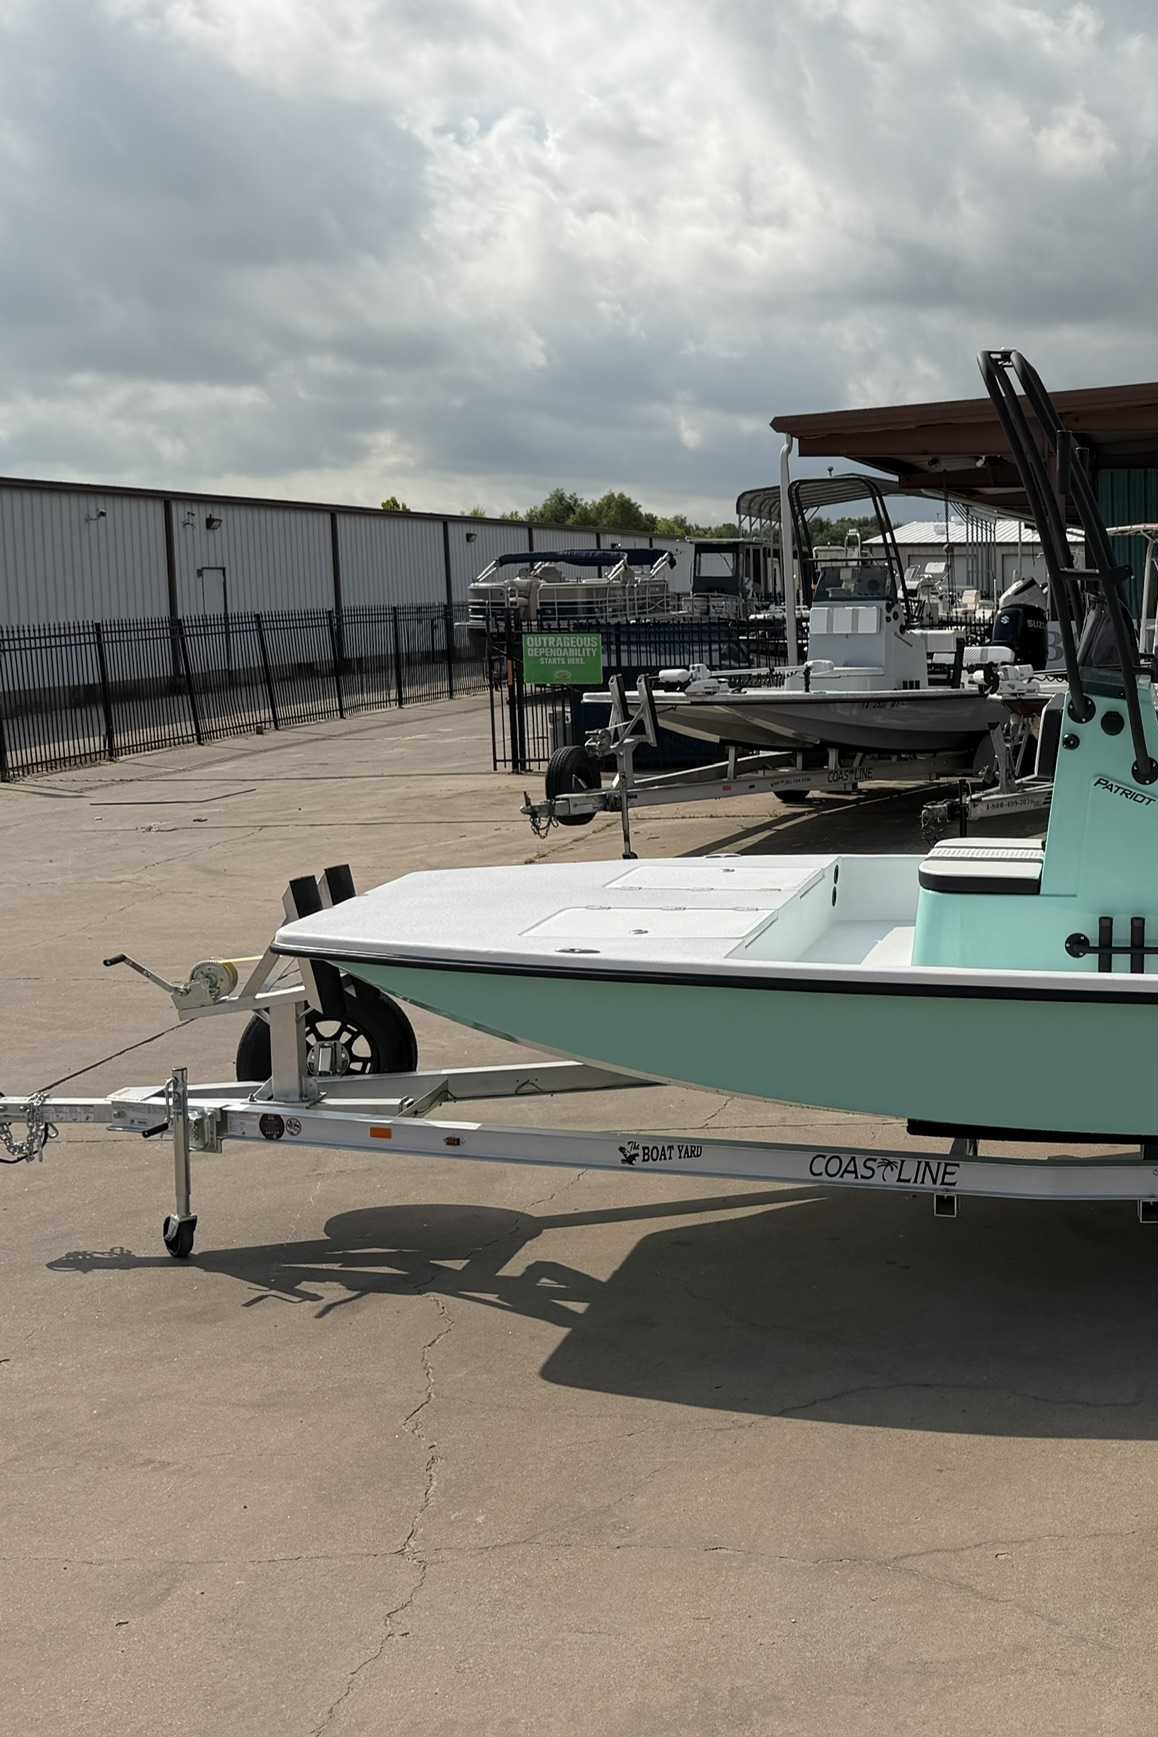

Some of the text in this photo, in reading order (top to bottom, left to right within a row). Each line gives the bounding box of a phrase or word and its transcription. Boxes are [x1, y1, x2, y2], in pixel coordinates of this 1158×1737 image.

[527, 636, 599, 648] OUTRAGEOUS
[527, 647, 598, 657] DEPENDABILITY
[539, 656, 566, 665] STARTS
[1093, 777, 1157, 806] PATRIOT
[627, 1140, 641, 1152] The
[641, 1144, 703, 1163] BOAT YARD
